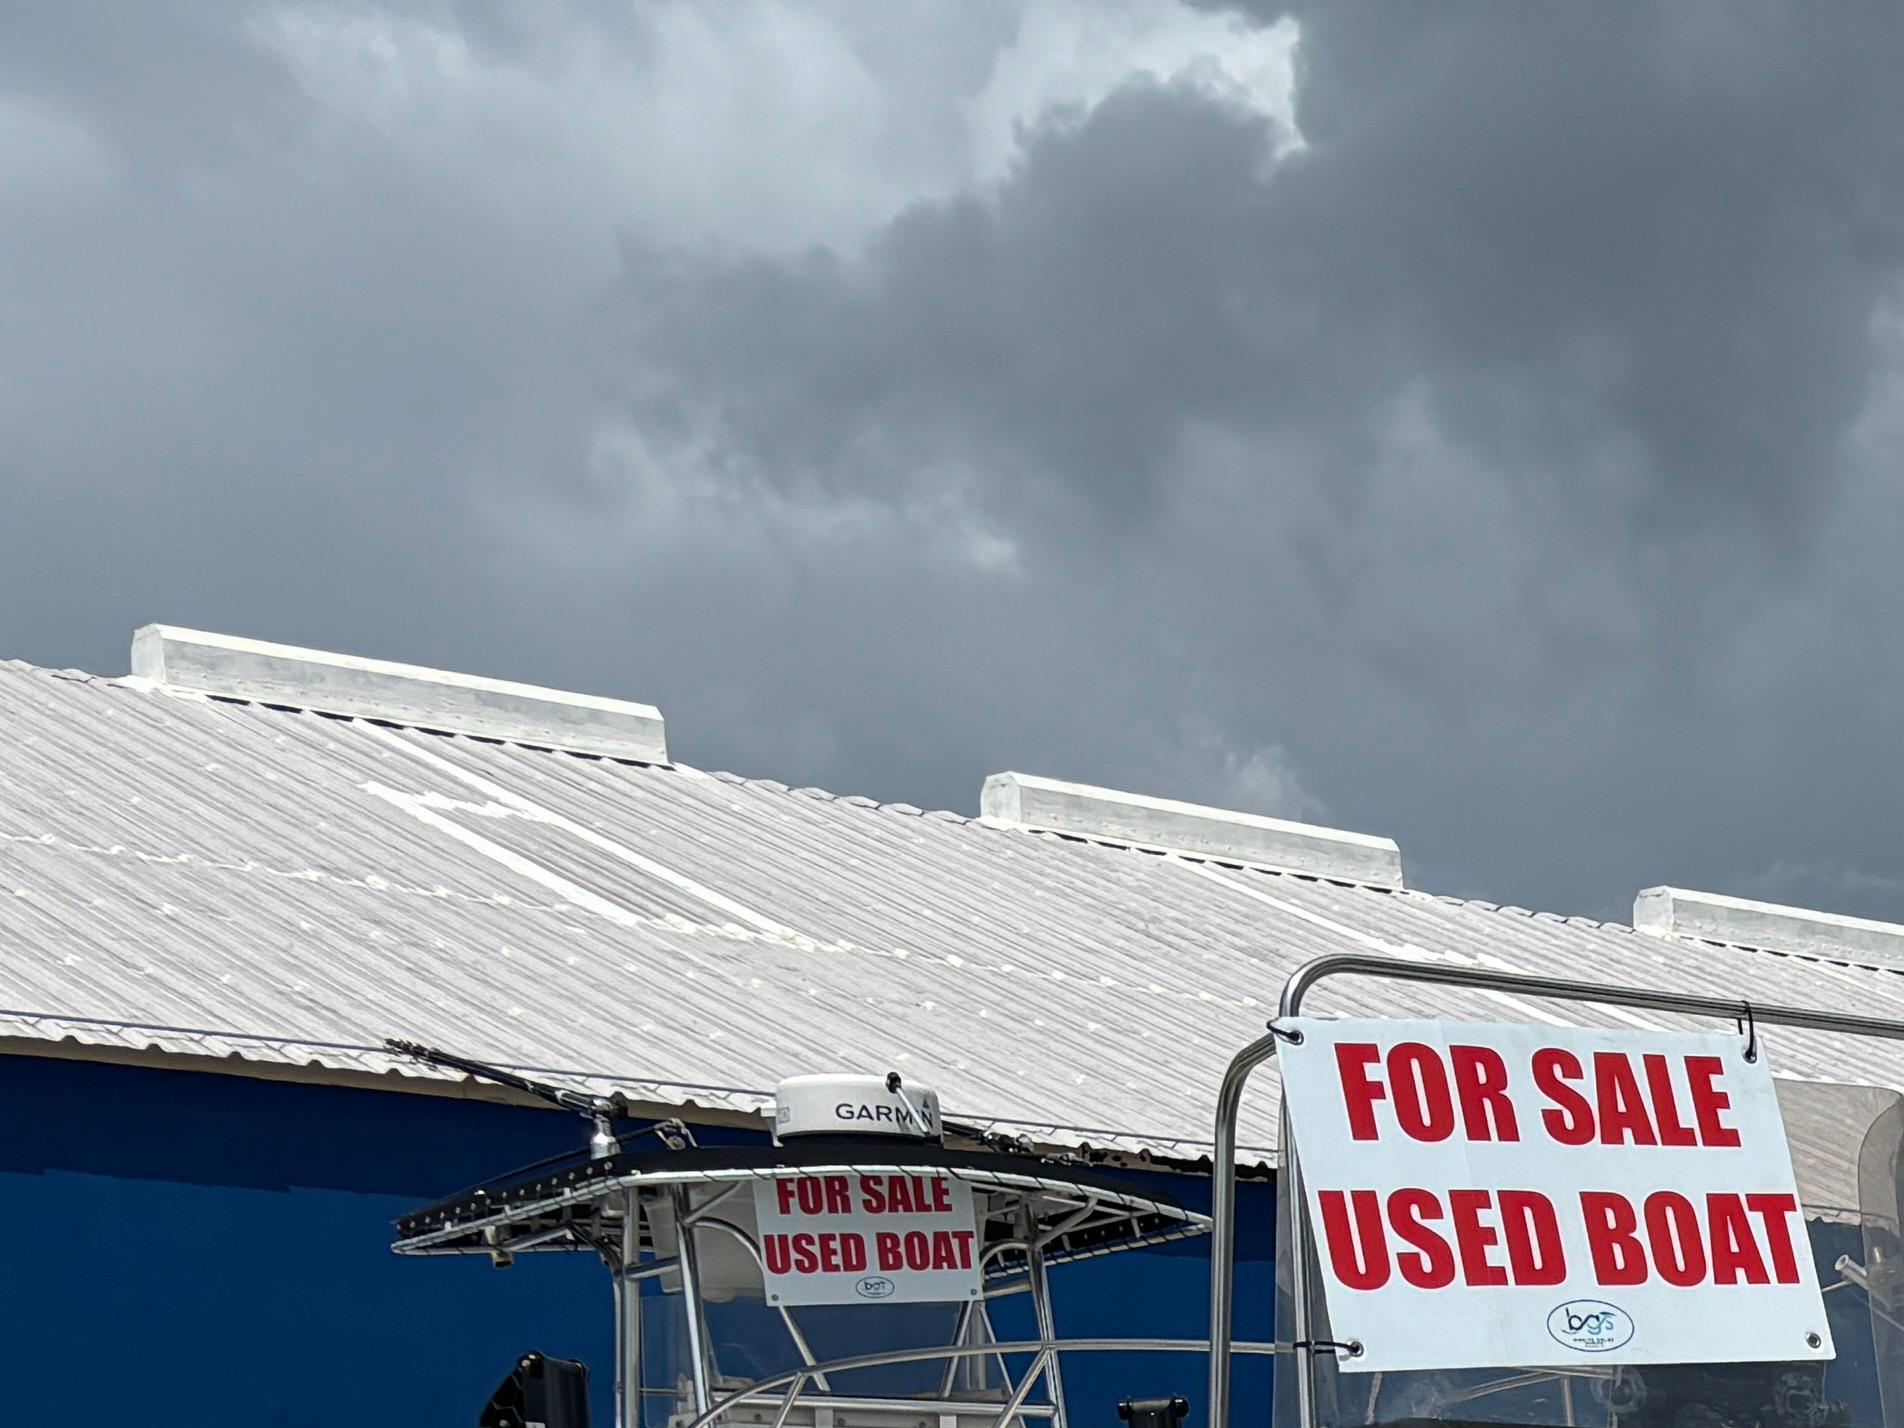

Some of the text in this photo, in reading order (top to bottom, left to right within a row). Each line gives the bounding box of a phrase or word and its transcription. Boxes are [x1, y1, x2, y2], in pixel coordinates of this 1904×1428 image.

[835, 1103, 933, 1127] GARMN
[1334, 1042, 1741, 1147] FOR SALE
[776, 1175, 952, 1215] FOR SALE
[763, 1231, 974, 1274] USED BOAT
[1318, 1187, 1801, 1290] USED BOAT
